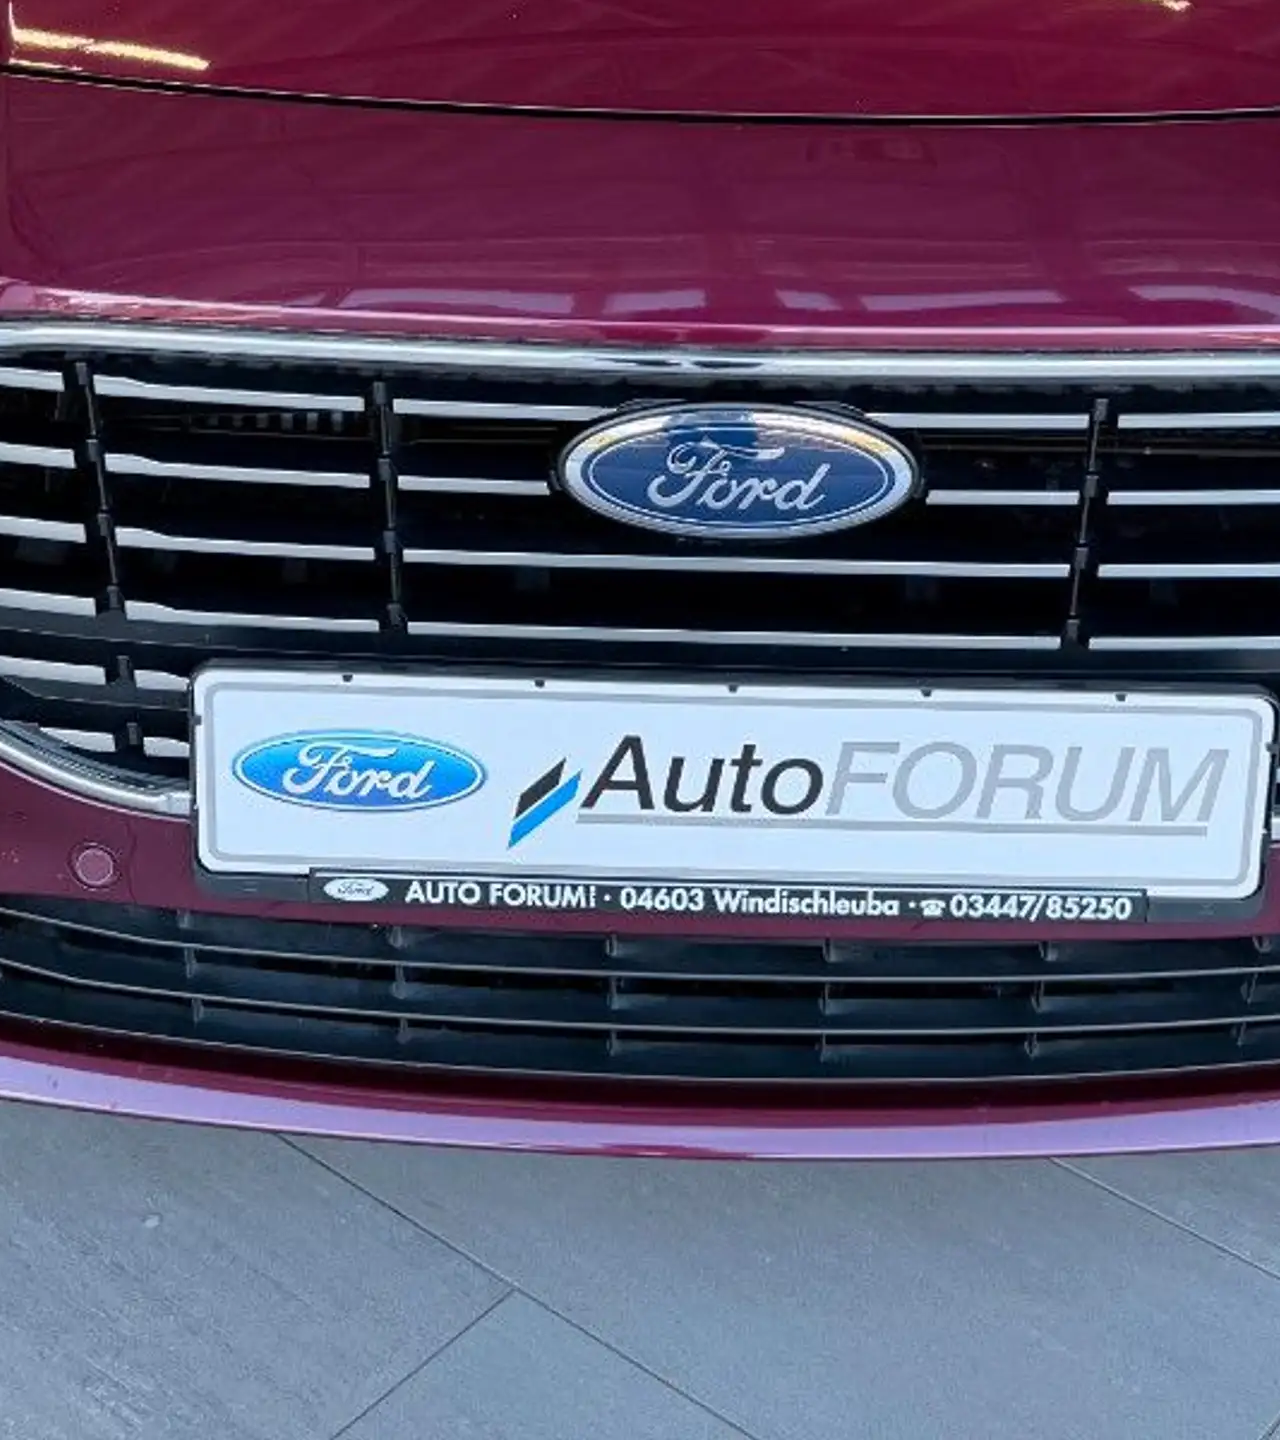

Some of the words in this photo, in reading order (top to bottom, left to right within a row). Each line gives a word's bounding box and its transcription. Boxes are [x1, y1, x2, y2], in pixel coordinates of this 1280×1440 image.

[646, 435, 832, 511] Ford
[282, 739, 436, 801] Ford
[582, 733, 1229, 823] AutoFORUM
[405, 881, 481, 905] AUTO
[620, 887, 705, 912] 04603
[713, 889, 900, 918] Windischleuba
[949, 894, 1132, 923] 03447/85250
